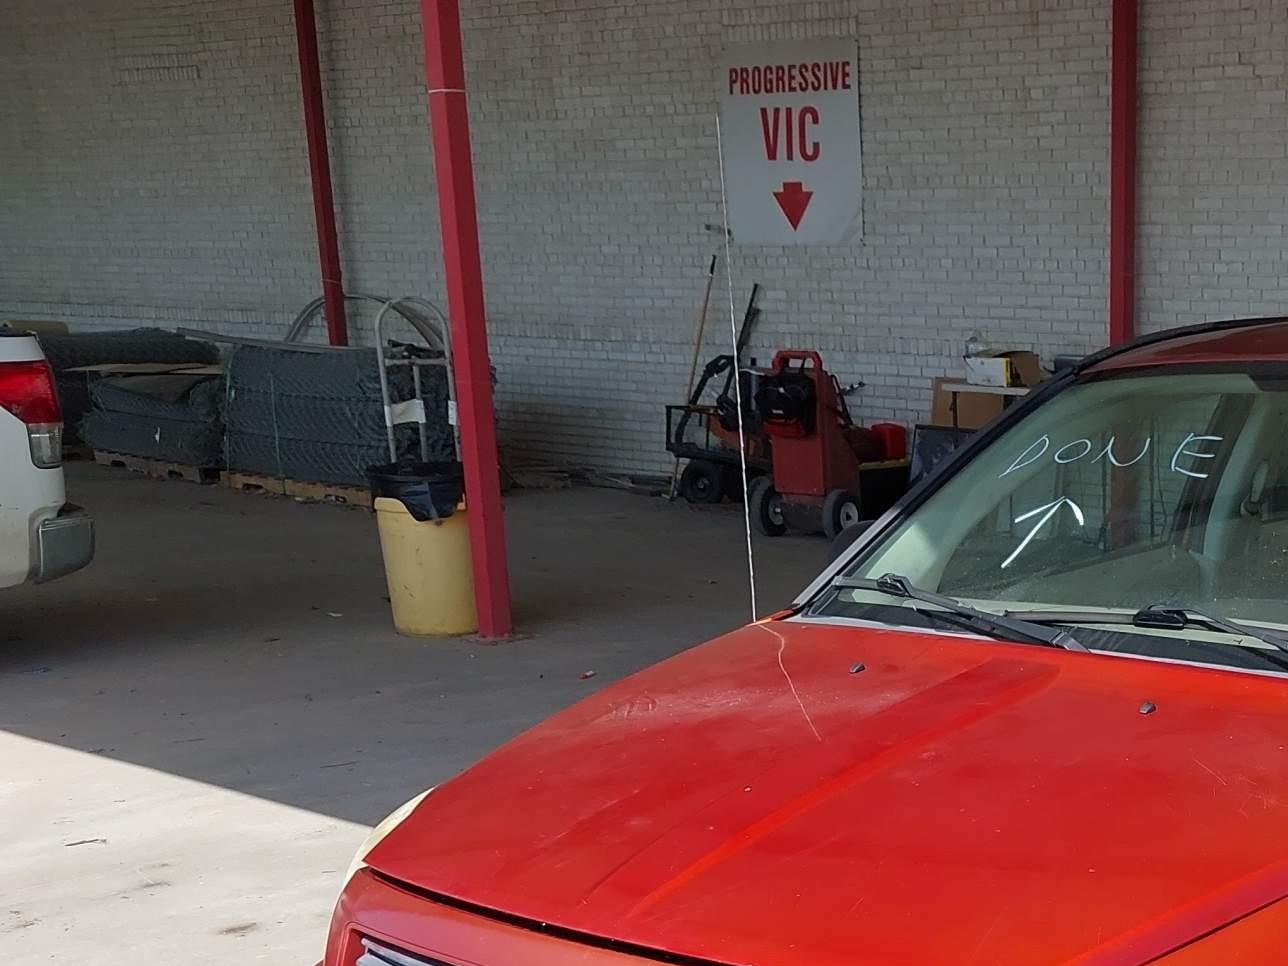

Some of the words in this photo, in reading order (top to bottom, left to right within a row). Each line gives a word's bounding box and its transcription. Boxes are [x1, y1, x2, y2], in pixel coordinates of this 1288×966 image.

[729, 61, 851, 95] PROGRESSIVE
[760, 105, 820, 162] VIC
[998, 433, 1224, 479] DONE
